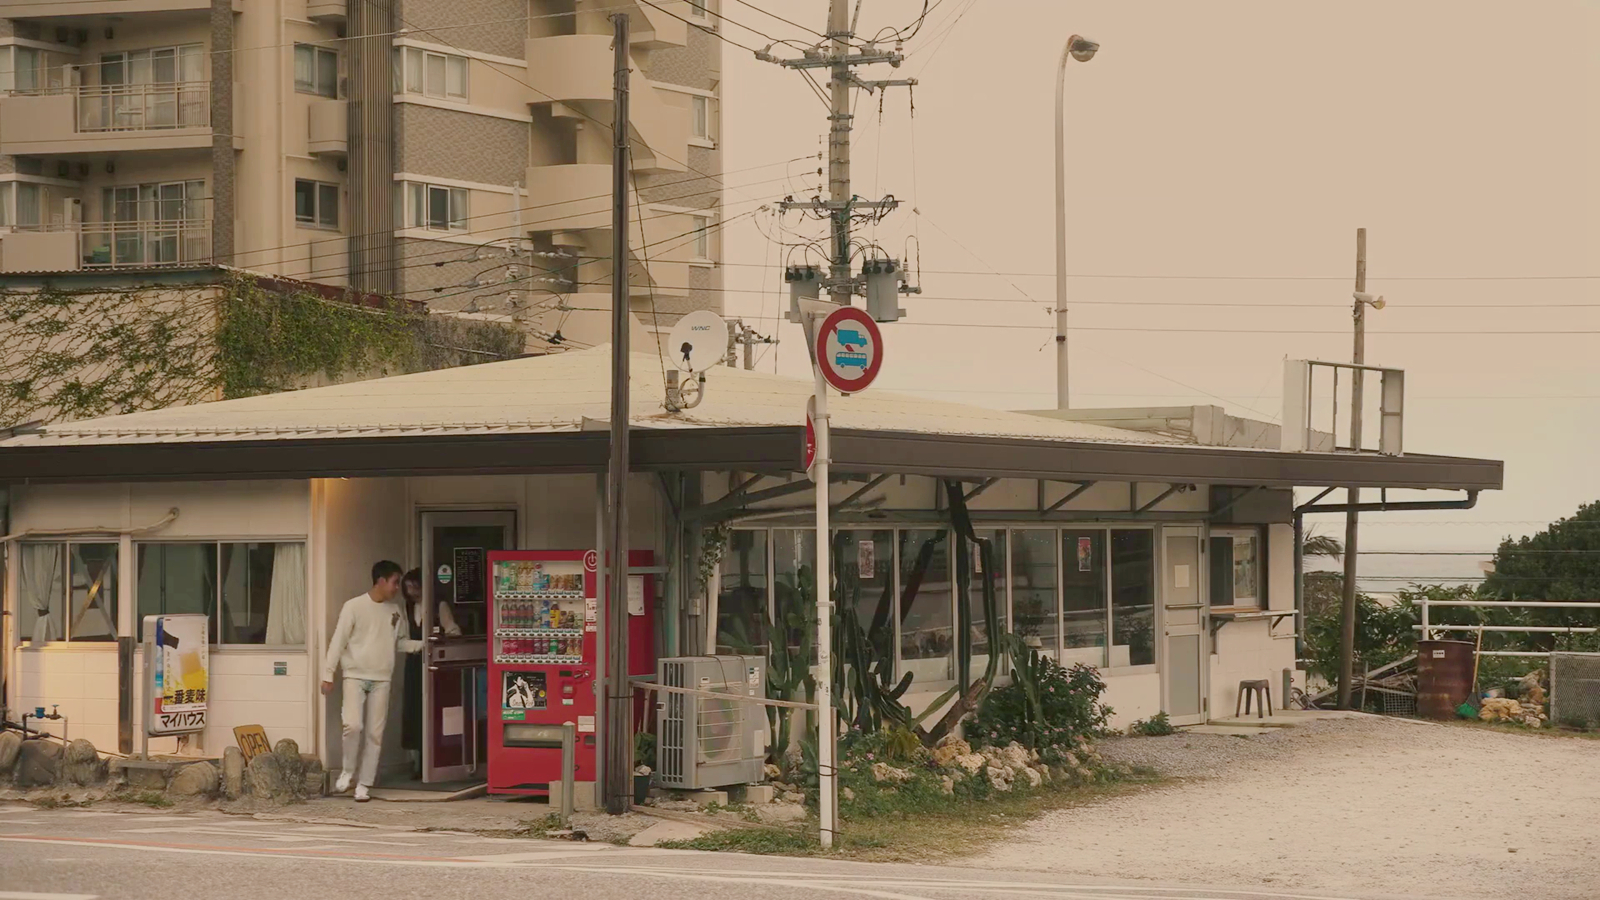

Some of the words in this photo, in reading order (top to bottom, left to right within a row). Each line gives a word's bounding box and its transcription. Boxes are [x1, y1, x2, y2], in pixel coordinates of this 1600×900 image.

[163, 688, 206, 705] 一番麦味
[160, 711, 205, 728] マイハウス
[240, 730, 272, 761] OPEN
